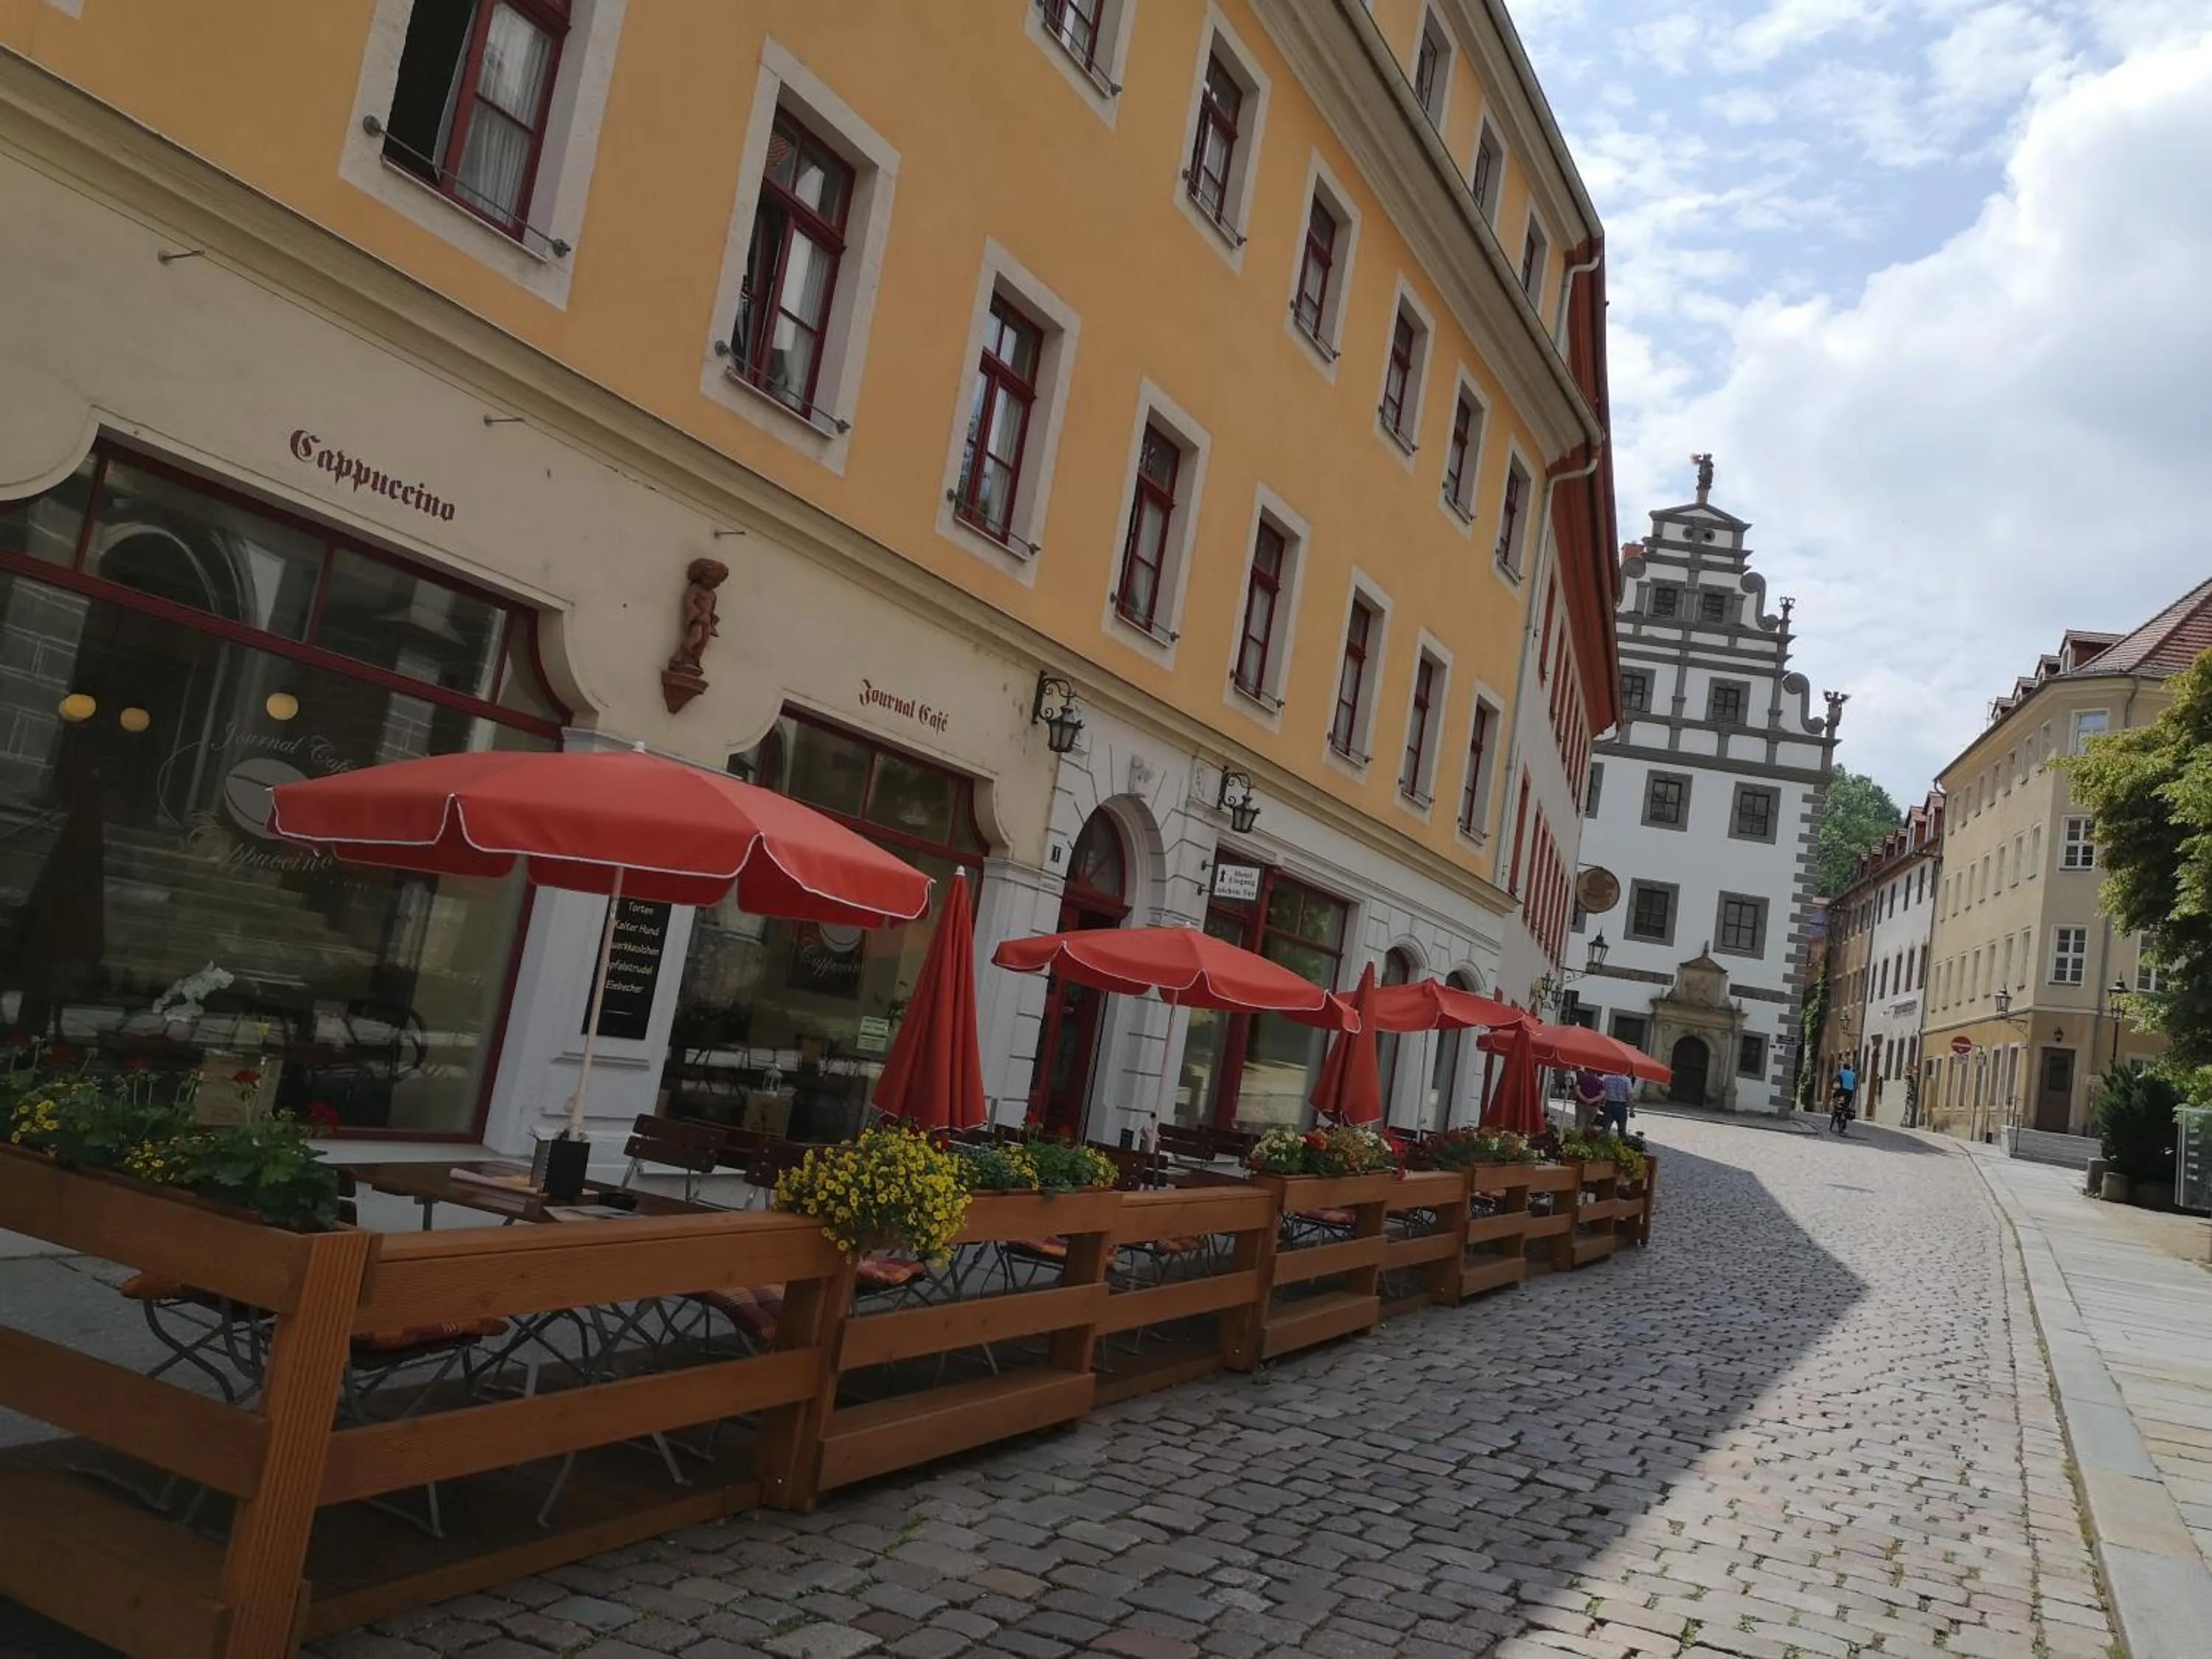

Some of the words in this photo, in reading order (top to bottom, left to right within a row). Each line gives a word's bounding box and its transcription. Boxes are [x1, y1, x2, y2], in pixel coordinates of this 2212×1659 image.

[290, 429, 456, 521] Cappuccino
[859, 678, 916, 718] Journal
[919, 703, 950, 736] Café
[210, 720, 305, 755] Journal
[609, 959, 653, 975] pfelstrudel
